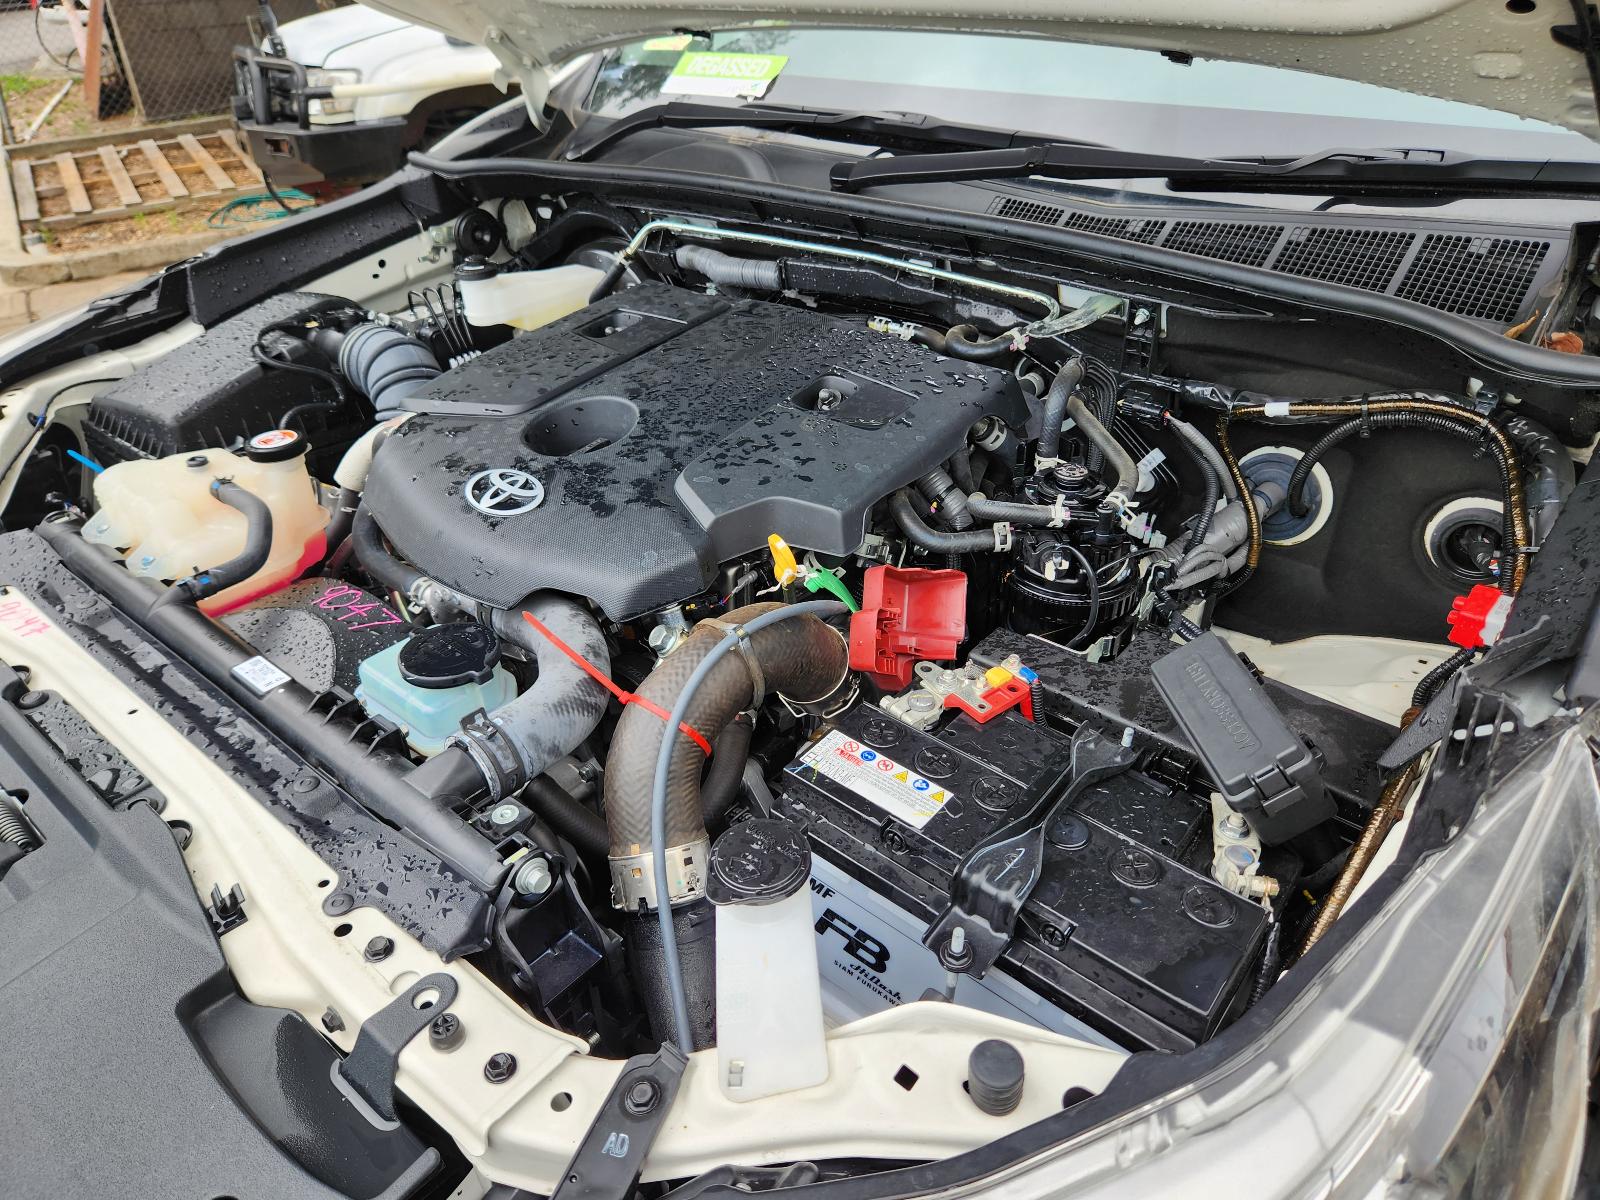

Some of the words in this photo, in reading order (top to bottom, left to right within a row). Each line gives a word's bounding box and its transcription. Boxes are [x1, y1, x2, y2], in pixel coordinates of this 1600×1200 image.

[814, 907, 891, 974] FB
[833, 960, 854, 977] SIAM
[856, 975, 901, 1007] FURUKAW
[601, 1132, 630, 1158] AD
